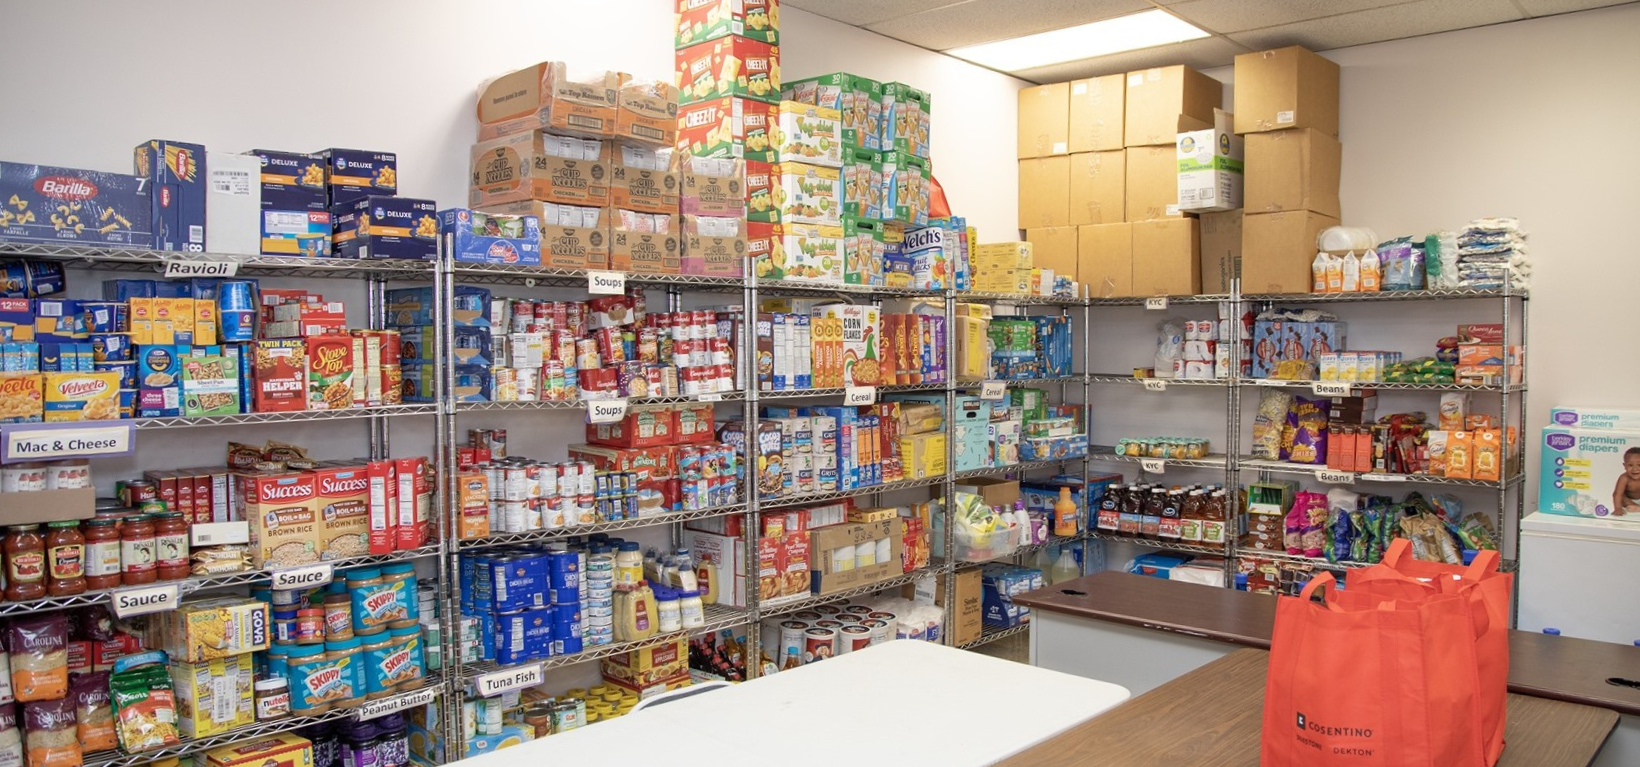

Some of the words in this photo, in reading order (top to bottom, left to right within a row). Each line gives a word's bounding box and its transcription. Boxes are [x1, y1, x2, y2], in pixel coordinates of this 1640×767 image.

[568, 89, 582, 99] Top
[581, 91, 605, 101] Ramen
[633, 100, 645, 110] Top
[686, 107, 717, 128] CHEEZ-IT
[271, 158, 298, 167] DELUXE
[348, 161, 373, 169] DELUXE
[492, 158, 508, 170] CUP
[535, 157, 547, 166] 24
[486, 167, 513, 184] NOODLES
[561, 168, 580, 178] CUP
[615, 167, 625, 176] 24
[42, 180, 91, 196] Barilla
[136, 178, 148, 192] 7
[552, 176, 587, 189] NOODLES
[637, 178, 655, 188] CUP
[629, 185, 661, 198] NOODLES
[309, 213, 317, 222] 12
[387, 211, 412, 219] DELUXE
[559, 237, 579, 246] CUP
[616, 233, 626, 241] 24
[551, 245, 585, 257] NOODLES
[638, 243, 656, 252] CUP
[630, 251, 662, 262] NOODLES
[169, 262, 228, 275] Ravioli
[594, 276, 622, 288] Soups
[1148, 298, 1162, 306] KYC
[843, 318, 861, 329] CORN
[843, 330, 861, 340] FLAKES
[259, 340, 280, 348] TWIN
[282, 339, 302, 347] PACK
[313, 346, 348, 369] Stove
[325, 359, 343, 374] Top
[61, 379, 105, 394] Velveeta
[262, 381, 303, 392] HELPER
[985, 388, 1003, 396] Cereal
[1316, 384, 1345, 393] Beans
[851, 392, 872, 402] Cereal
[595, 405, 622, 417] Soups
[1580, 413, 1619, 421] premium
[1581, 420, 1614, 428] diapers
[759, 431, 781, 444] Cocoa
[1578, 435, 1627, 445] premium
[16, 442, 48, 453] Mac
[52, 441, 64, 451] &
[68, 438, 117, 450] Cheese
[1578, 444, 1619, 453] diapers
[1145, 462, 1159, 470] KYC
[1320, 473, 1350, 482] Beans
[321, 477, 368, 493] Success
[262, 483, 312, 500] Success
[1551, 502, 1566, 510] 180
[326, 519, 351, 529] BROWN
[353, 517, 367, 525] RICE
[268, 528, 295, 537] BROWN
[297, 525, 312, 533] RICE
[278, 569, 323, 585] Sauce
[119, 590, 168, 609] Sauce
[367, 591, 395, 612] SKIPPY
[328, 612, 348, 624] SKIPPY
[252, 610, 264, 645] GOYA
[24, 636, 63, 648] CAROLINA
[384, 650, 409, 673] SKIPPY
[309, 668, 340, 690] SKIPPY
[486, 678, 512, 691] Tuna
[515, 669, 536, 683] Fish
[362, 700, 399, 717] Peanut
[399, 692, 431, 709] Butter
[1308, 721, 1373, 738] COSENTINO
[1333, 747, 1372, 756] DEKTON
